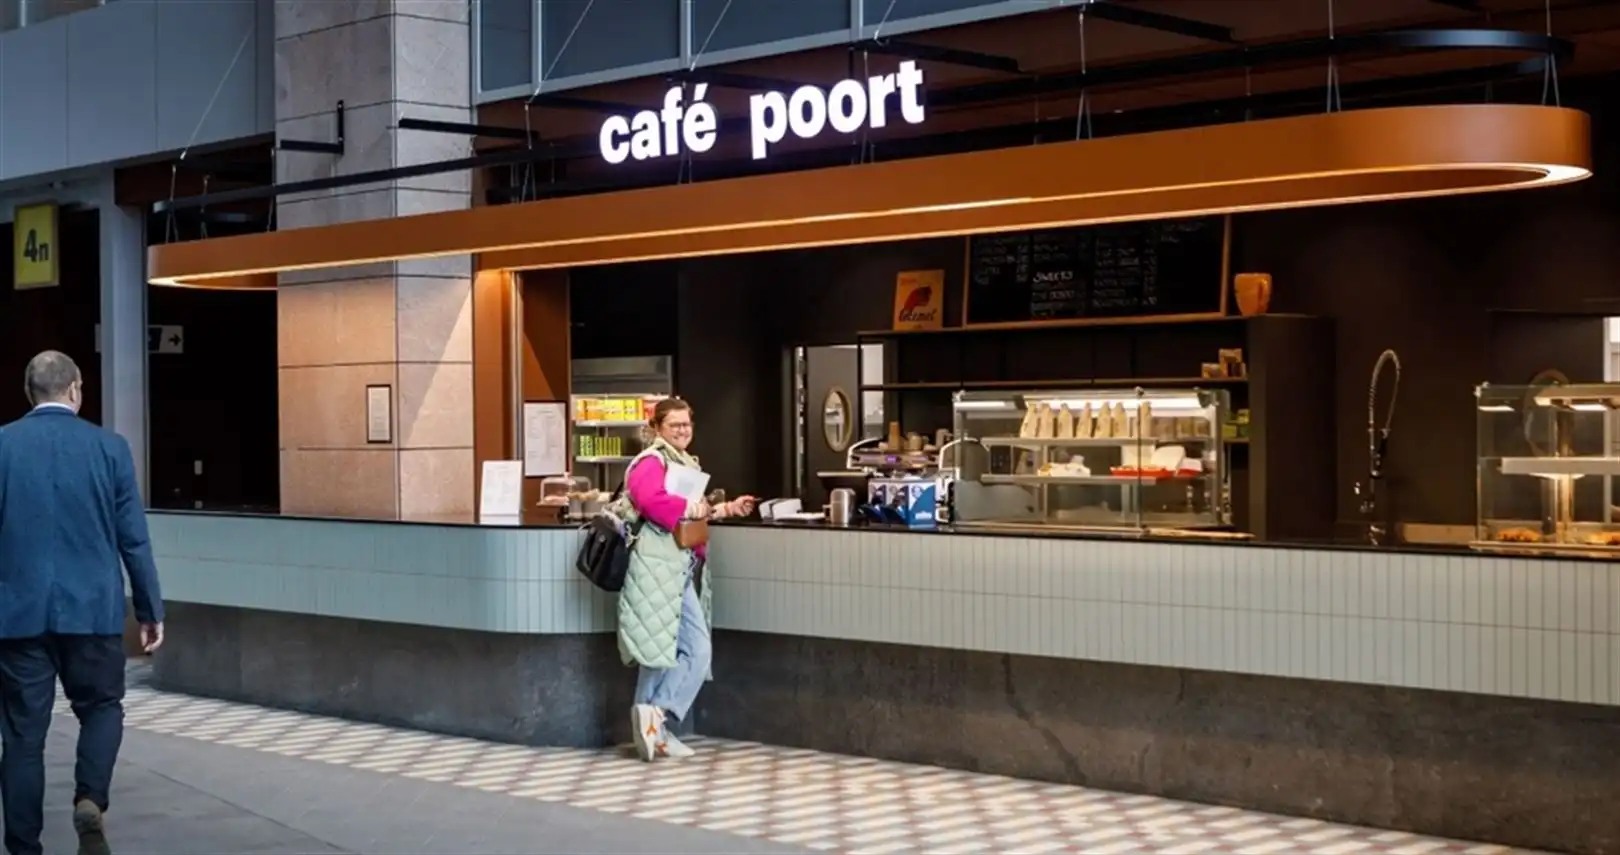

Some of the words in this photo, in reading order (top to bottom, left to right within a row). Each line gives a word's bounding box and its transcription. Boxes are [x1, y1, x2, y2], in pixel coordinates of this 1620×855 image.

[599, 83, 717, 163] café
[750, 60, 925, 160] poort
[23, 228, 49, 262] 4n
